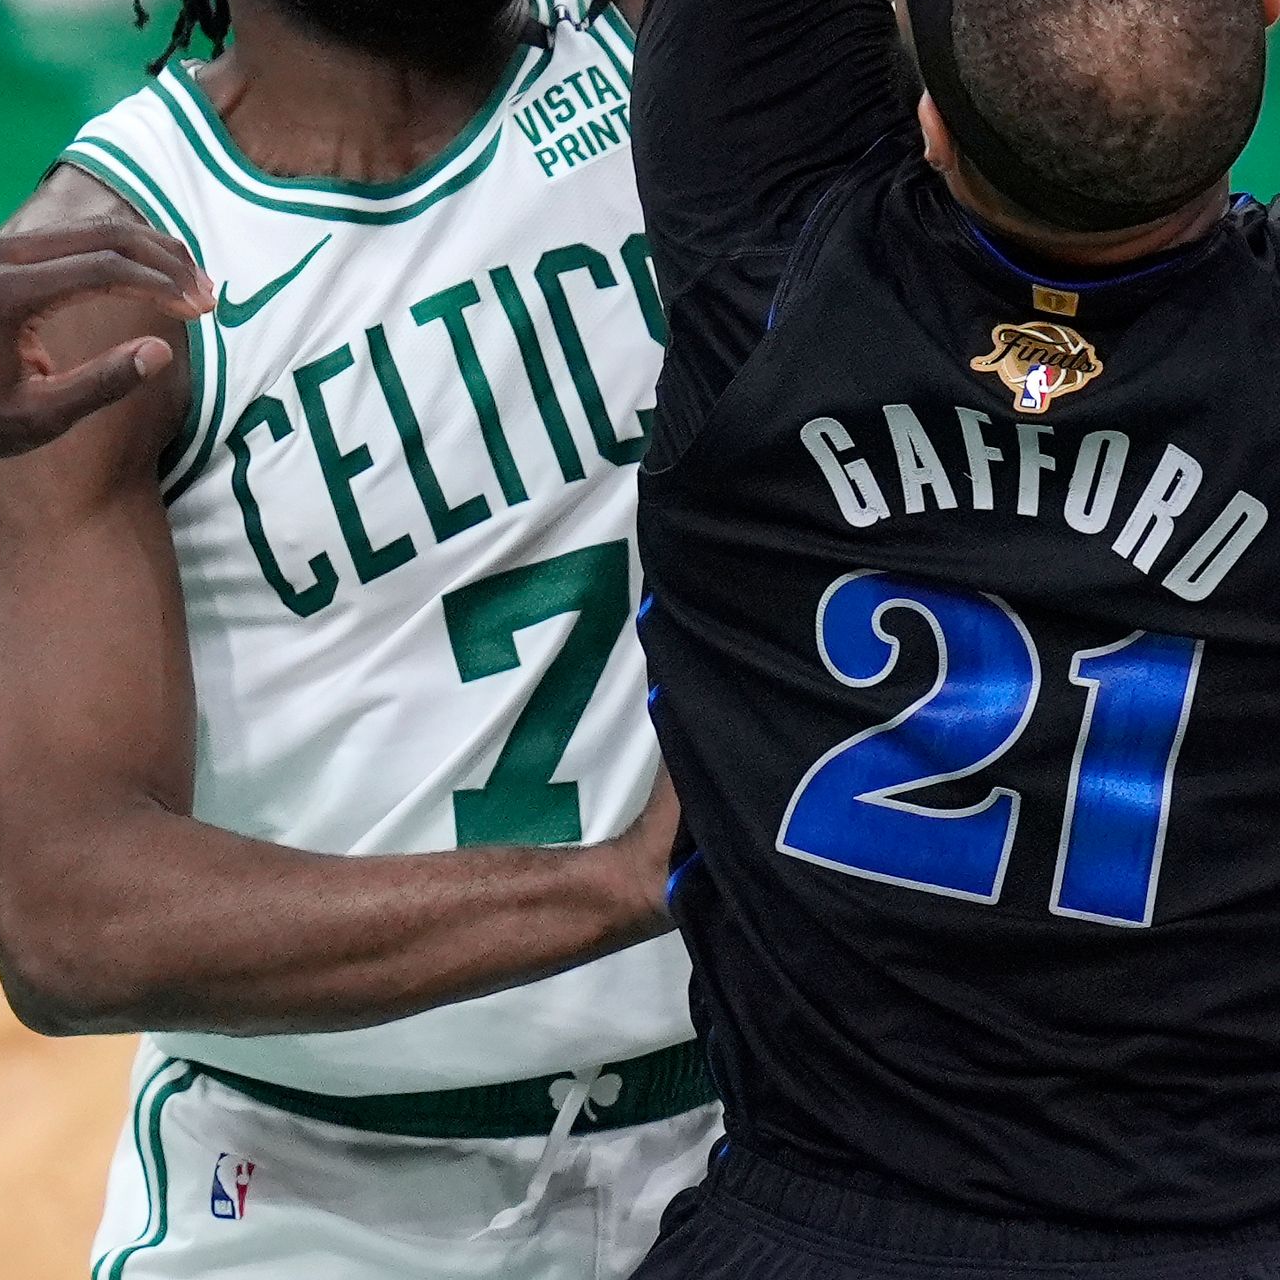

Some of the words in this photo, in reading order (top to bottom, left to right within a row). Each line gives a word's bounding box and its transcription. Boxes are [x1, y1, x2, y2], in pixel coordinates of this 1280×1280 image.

[513, 65, 623, 146] VISTA
[534, 103, 632, 177] PRINT
[799, 404, 1269, 602] GAFFORD
[441, 537, 631, 847] 7
[775, 567, 1206, 928] 21
